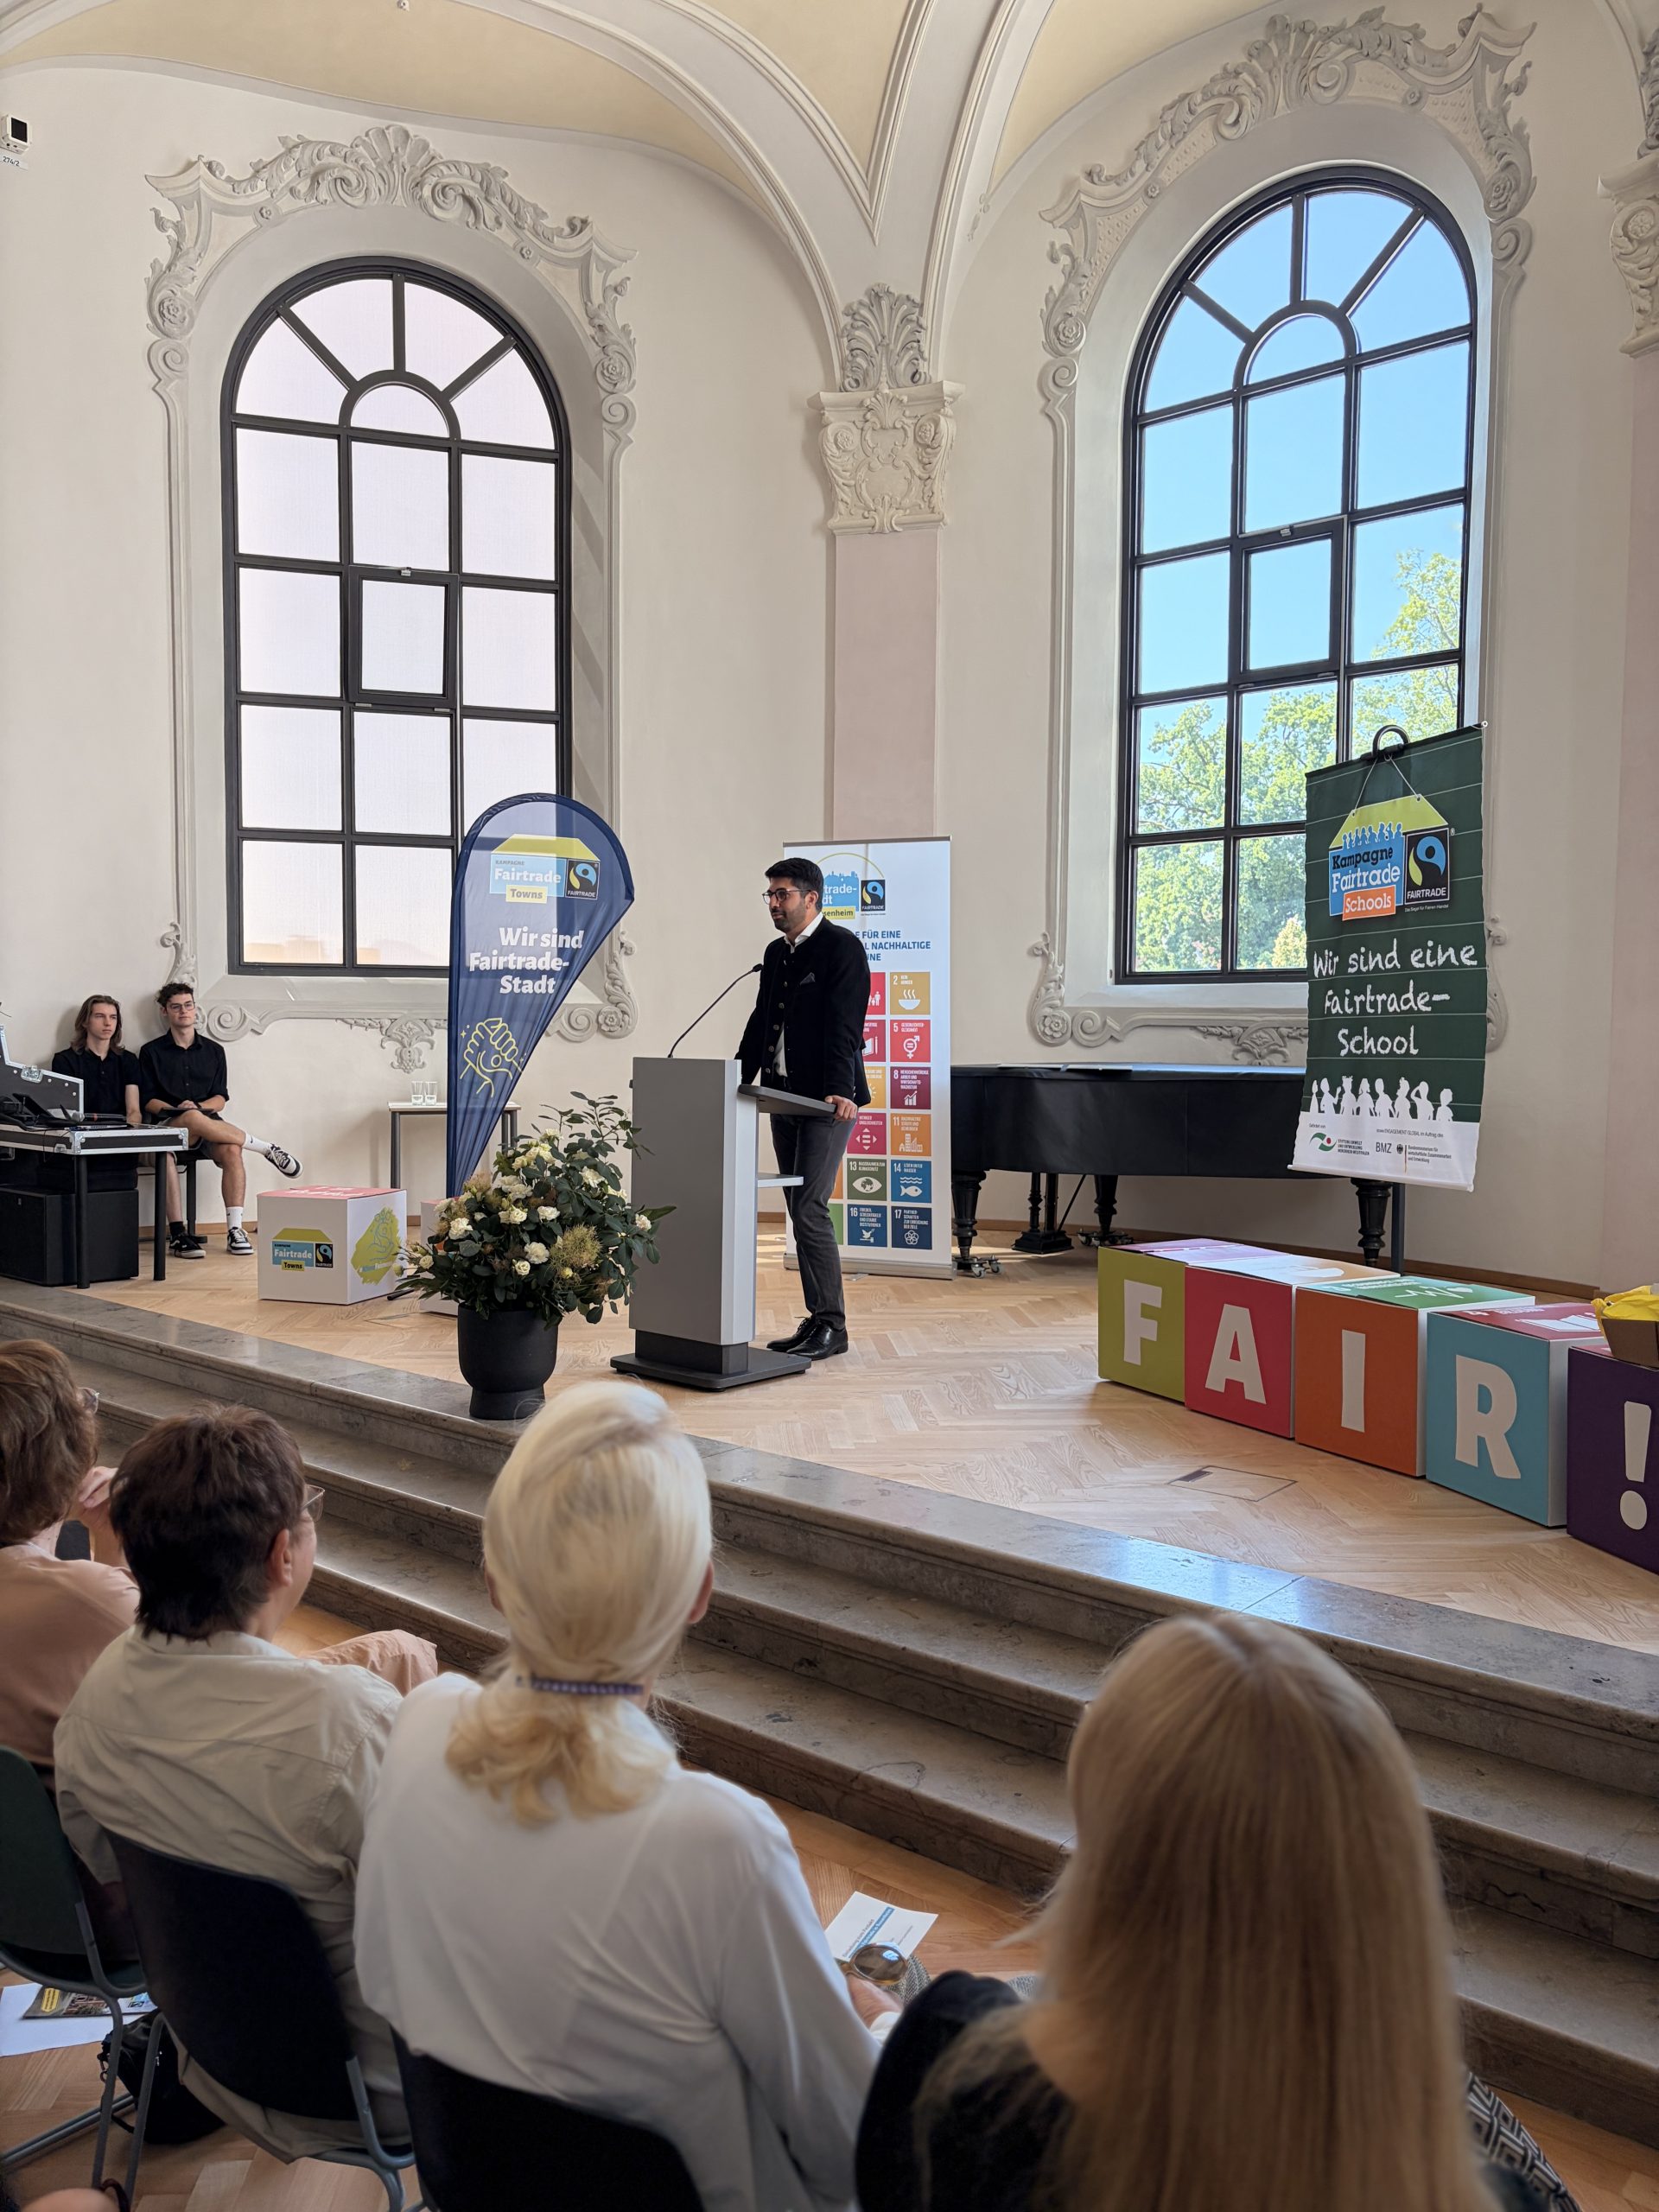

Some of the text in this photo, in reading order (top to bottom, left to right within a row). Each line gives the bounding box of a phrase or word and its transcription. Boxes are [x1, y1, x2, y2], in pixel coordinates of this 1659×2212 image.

[1332, 847, 1393, 869] Kampagne
[494, 868, 562, 883] Fairtrade
[1332, 863, 1401, 893] Fairtrade
[511, 889, 543, 899] Towns
[824, 883, 857, 894] trade-
[1407, 887, 1446, 899] FAIRTRADE
[1345, 893, 1391, 912] Schools
[499, 925, 584, 949] Wir sind
[862, 929, 879, 938] FÜR
[881, 930, 901, 938] EINE
[871, 941, 931, 950] NACHHALTIGE
[469, 950, 569, 971] Fairtrade-
[1313, 938, 1478, 978] Wir sind eine
[499, 975, 556, 994] Stadt
[893, 975, 898, 985] 2
[1325, 979, 1451, 1014] Fairtrade-
[893, 1022, 899, 1033] 5
[1338, 1025, 1419, 1056] School
[893, 1069, 899, 1079] 8
[893, 1116, 899, 1127] 11
[1376, 1141, 1392, 1154] BMZ
[849, 1160, 857, 1171] 13
[893, 1163, 901, 1173] 14
[850, 1207, 858, 1217] 16
[894, 1209, 902, 1219] 17
[274, 1249, 312, 1258] Fairtrade
